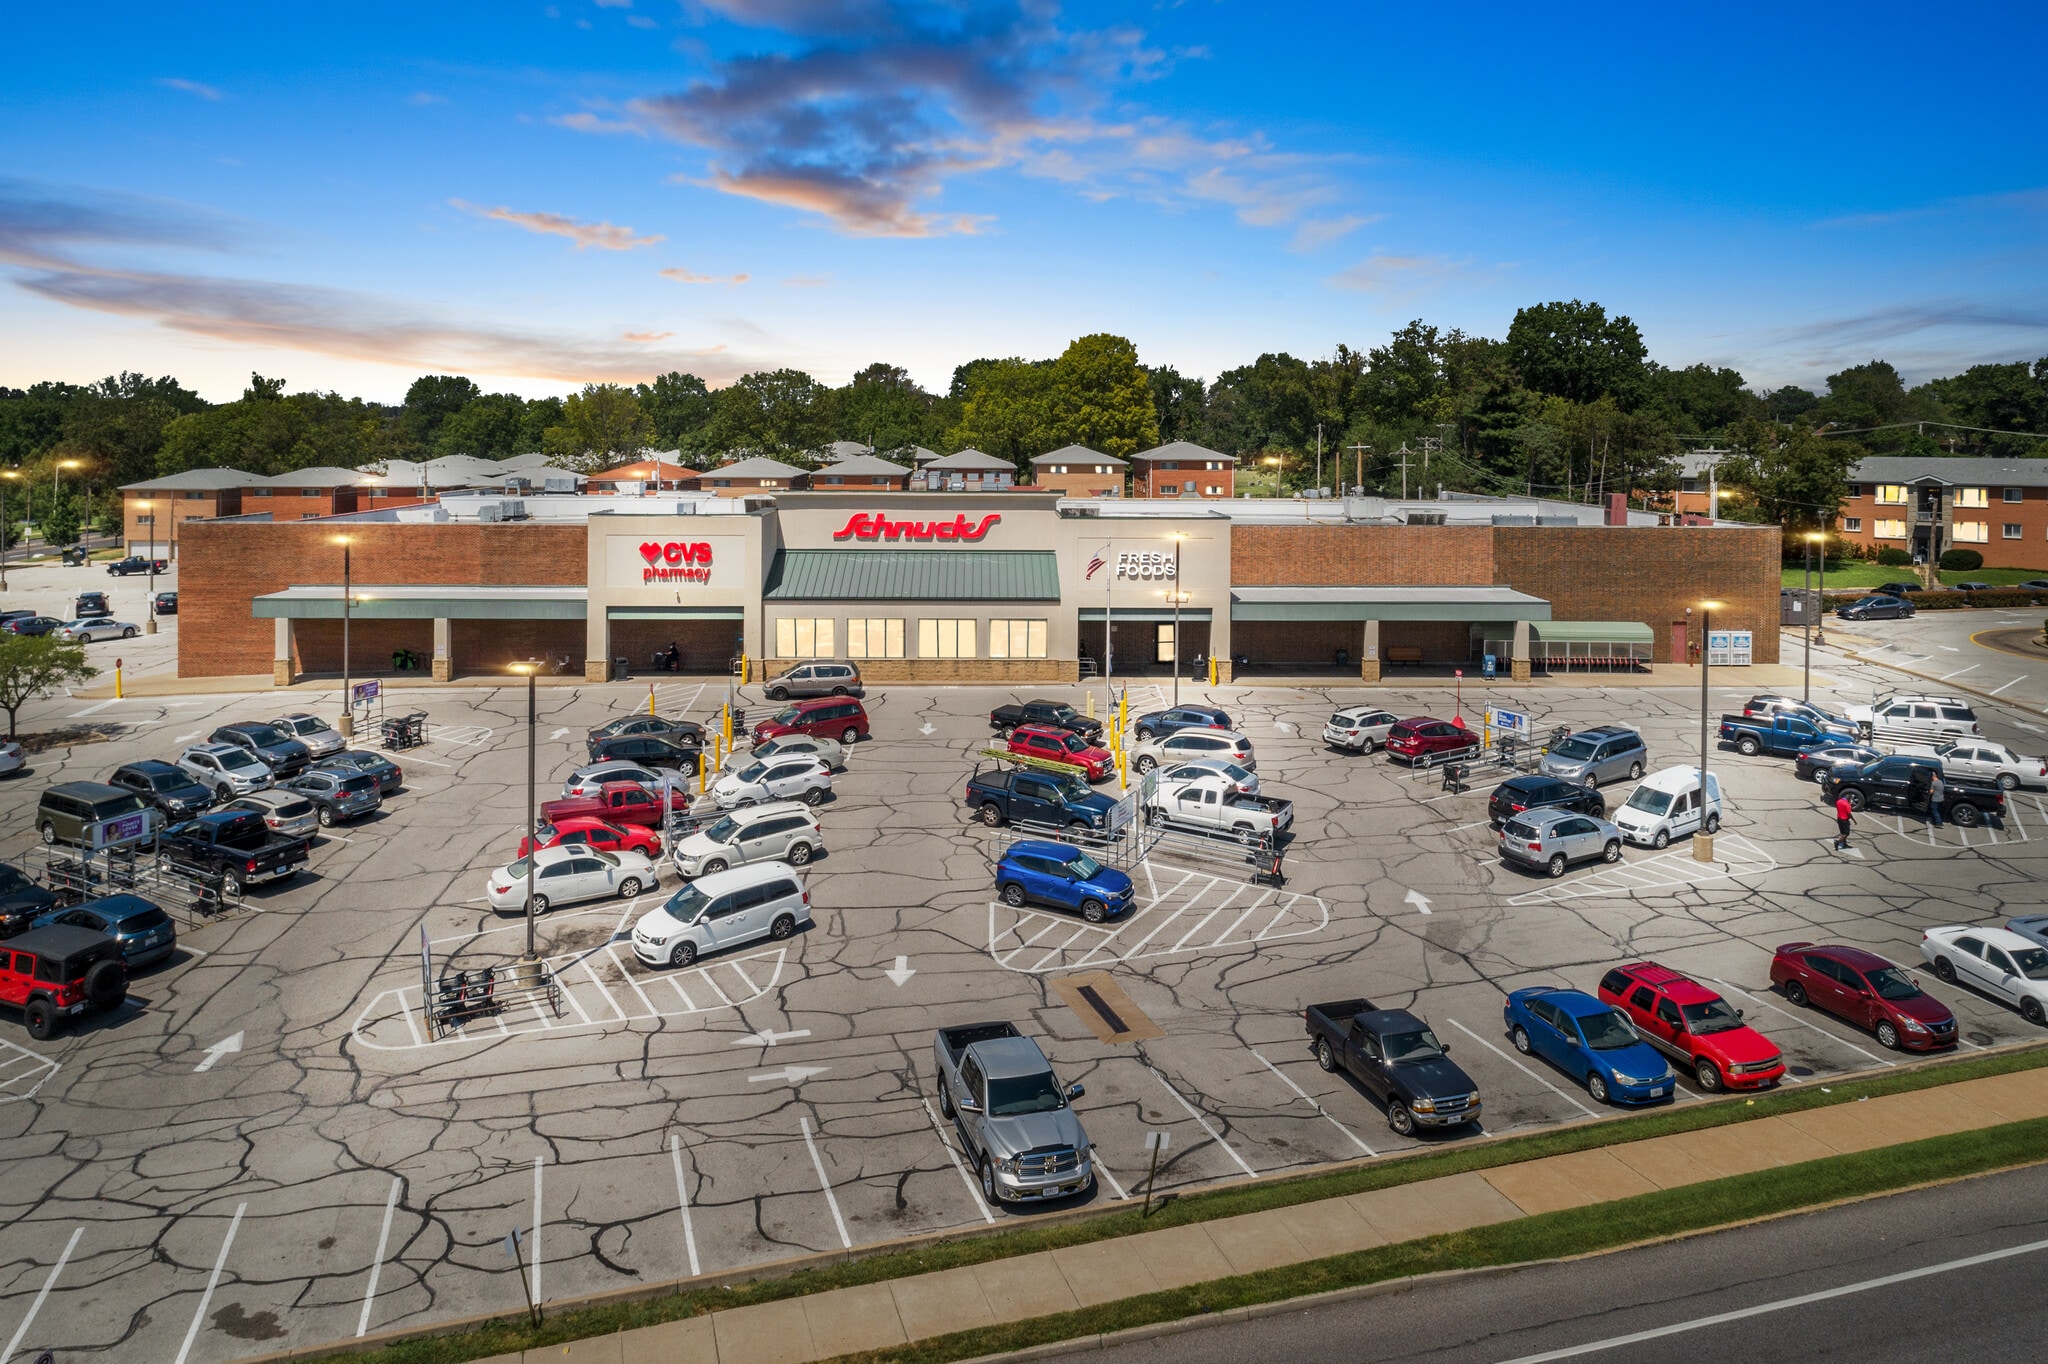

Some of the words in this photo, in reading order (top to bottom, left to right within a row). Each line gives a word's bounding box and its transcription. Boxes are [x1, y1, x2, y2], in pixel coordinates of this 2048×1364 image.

[833, 513, 1001, 540] Schnucks
[663, 542, 713, 563] CVS
[1119, 552, 1174, 563] FRESH
[643, 565, 710, 581] pharmacy
[1117, 564, 1176, 576] FOODS
